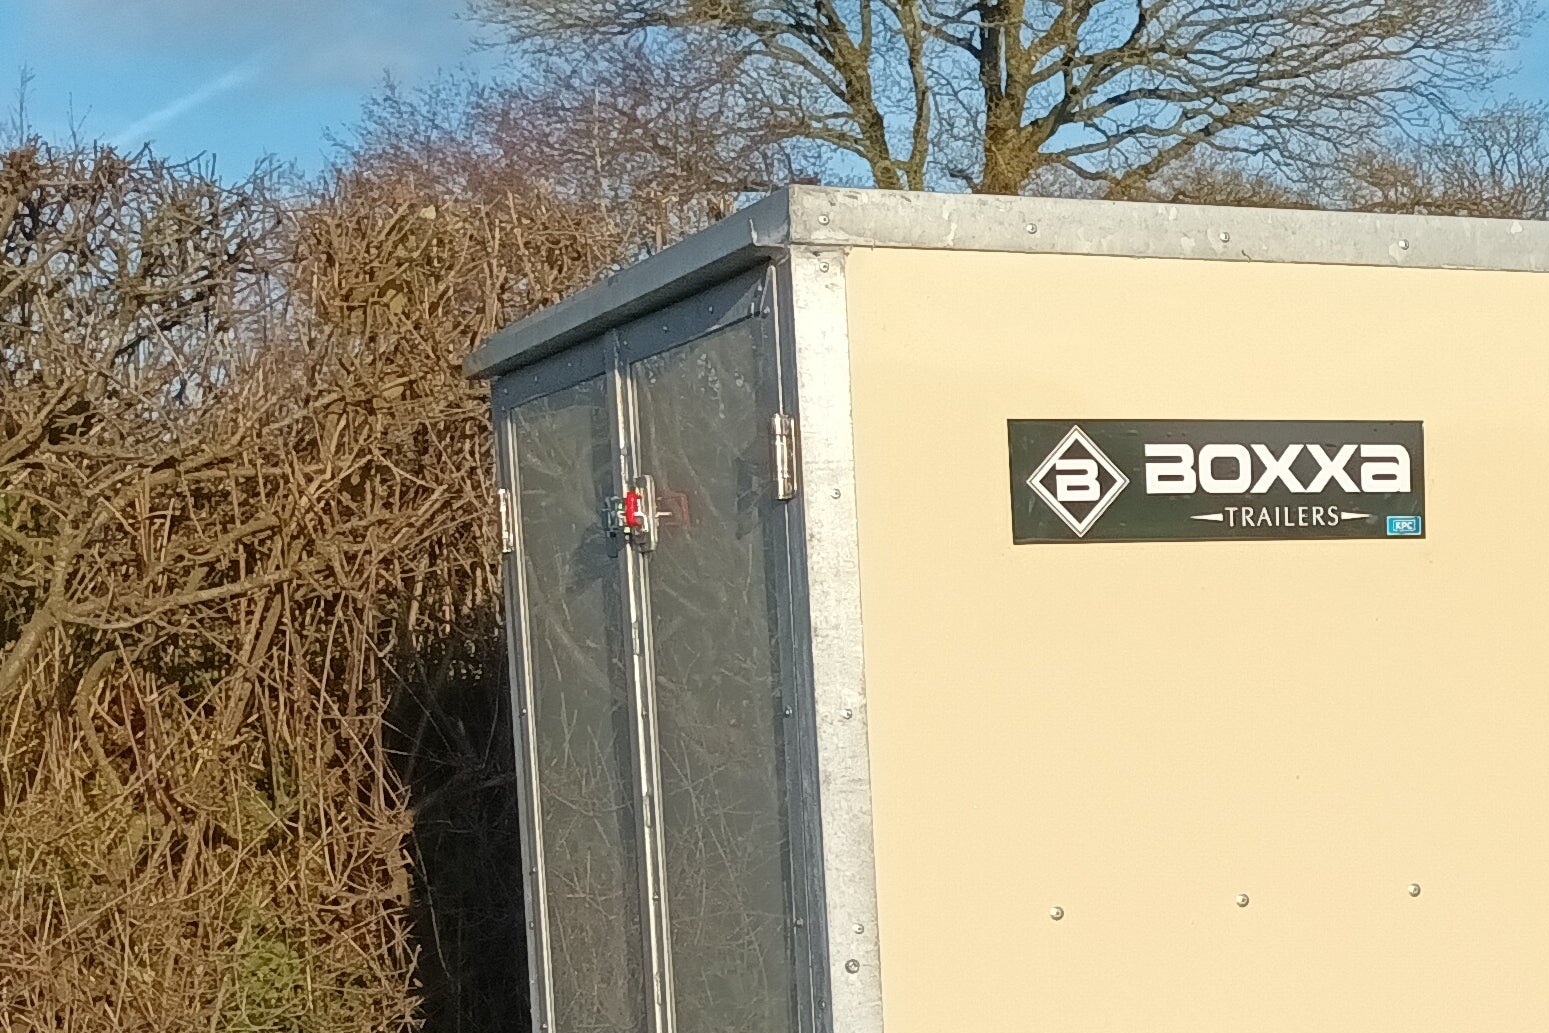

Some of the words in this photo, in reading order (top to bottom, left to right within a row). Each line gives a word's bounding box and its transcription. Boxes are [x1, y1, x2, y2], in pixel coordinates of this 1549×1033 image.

[1055, 458, 1101, 502] B
[1224, 505, 1340, 528] TRAILERS
[1395, 521, 1413, 530] KPC
